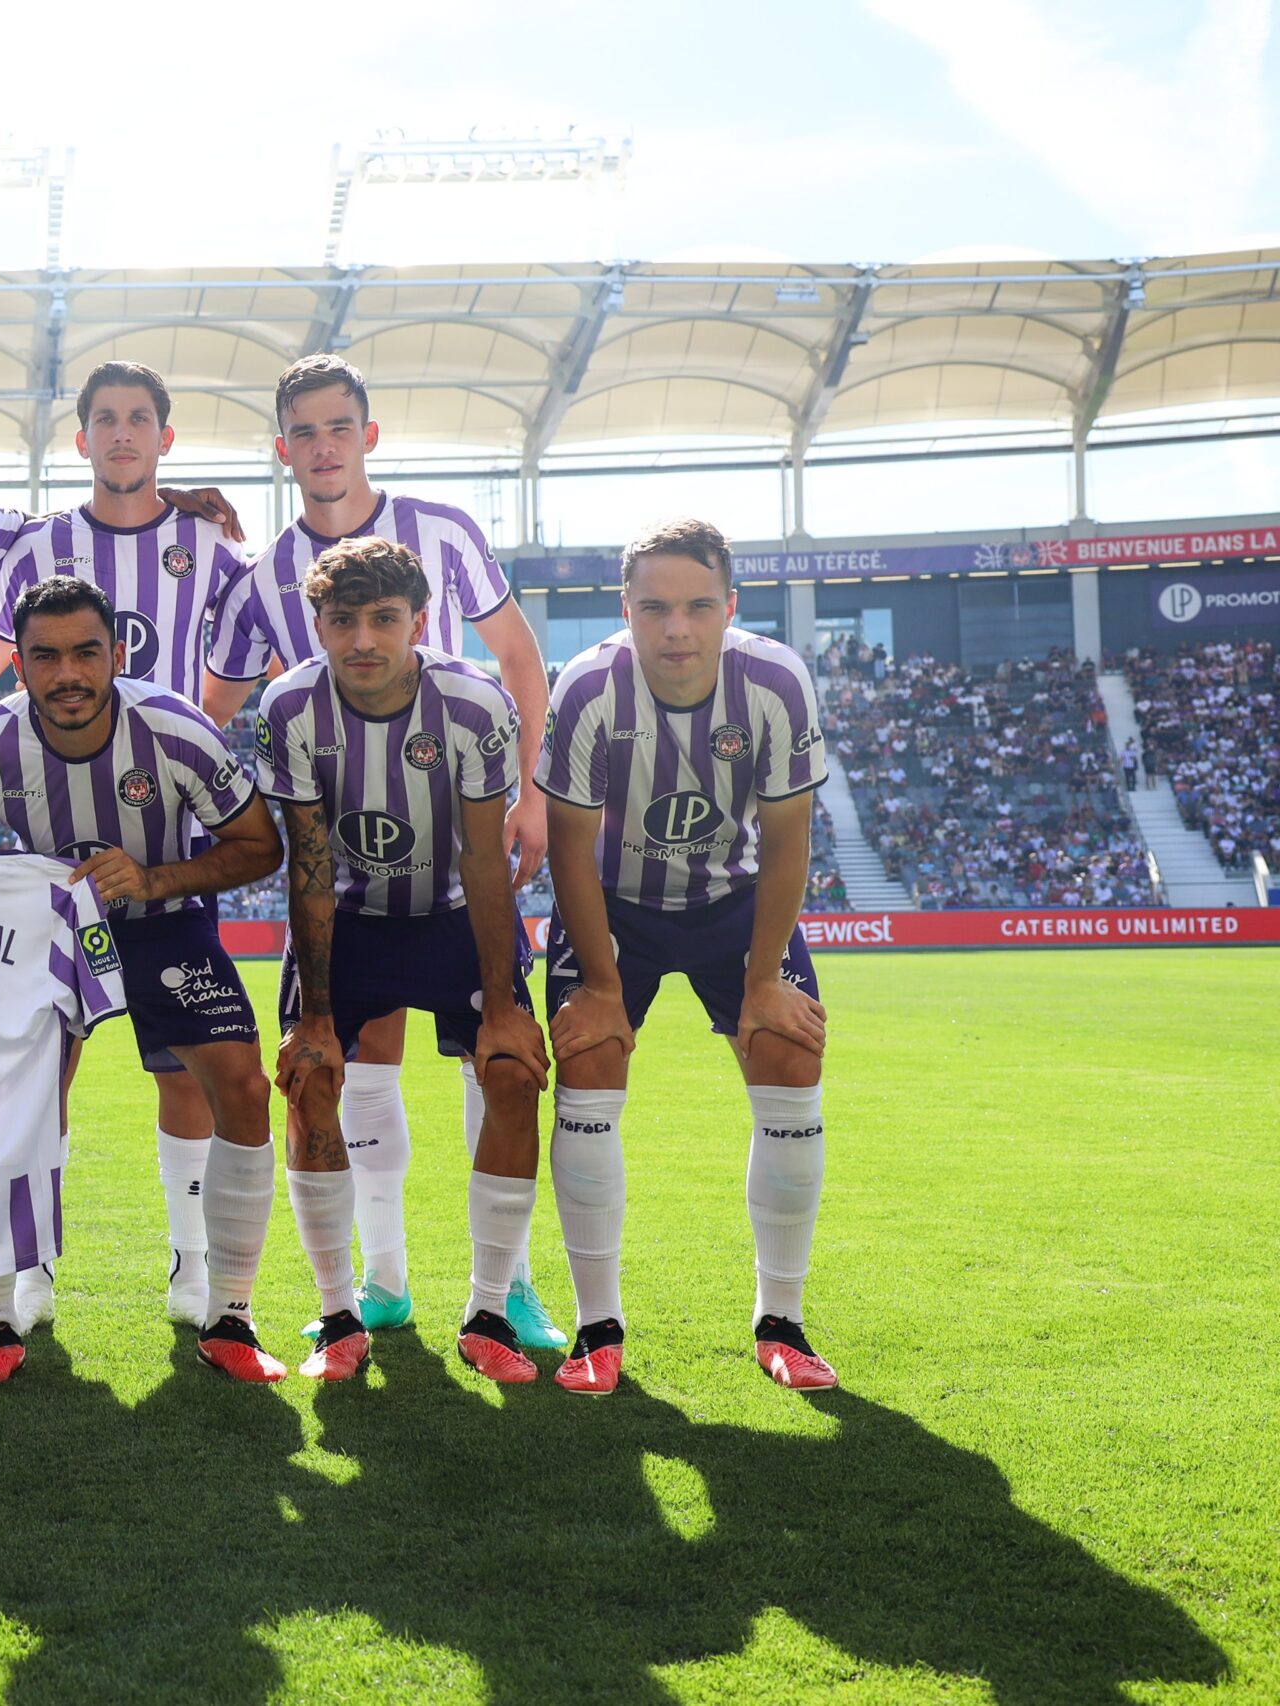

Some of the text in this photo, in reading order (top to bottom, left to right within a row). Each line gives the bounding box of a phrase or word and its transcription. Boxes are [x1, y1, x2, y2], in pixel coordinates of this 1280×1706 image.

[1077, 531, 1277, 560] BIENVENUE DANS LA
[55, 556, 84, 566] CRAFT
[785, 555, 809, 573] AU
[613, 730, 645, 739] CRAFT
[4, 789, 37, 799] CRAFT
[666, 796, 710, 840] LP
[359, 814, 400, 860] LP
[622, 837, 735, 861] PROMOTION
[1001, 916, 1239, 937] CATERING UNLIMITED
[91, 956, 111, 967] LIGUE
[92, 961, 120, 975] Uber Eats
[180, 957, 213, 981] Sud
[192, 977, 219, 991] de
[170, 982, 239, 1008] France
[210, 1024, 244, 1035] CRAFT
